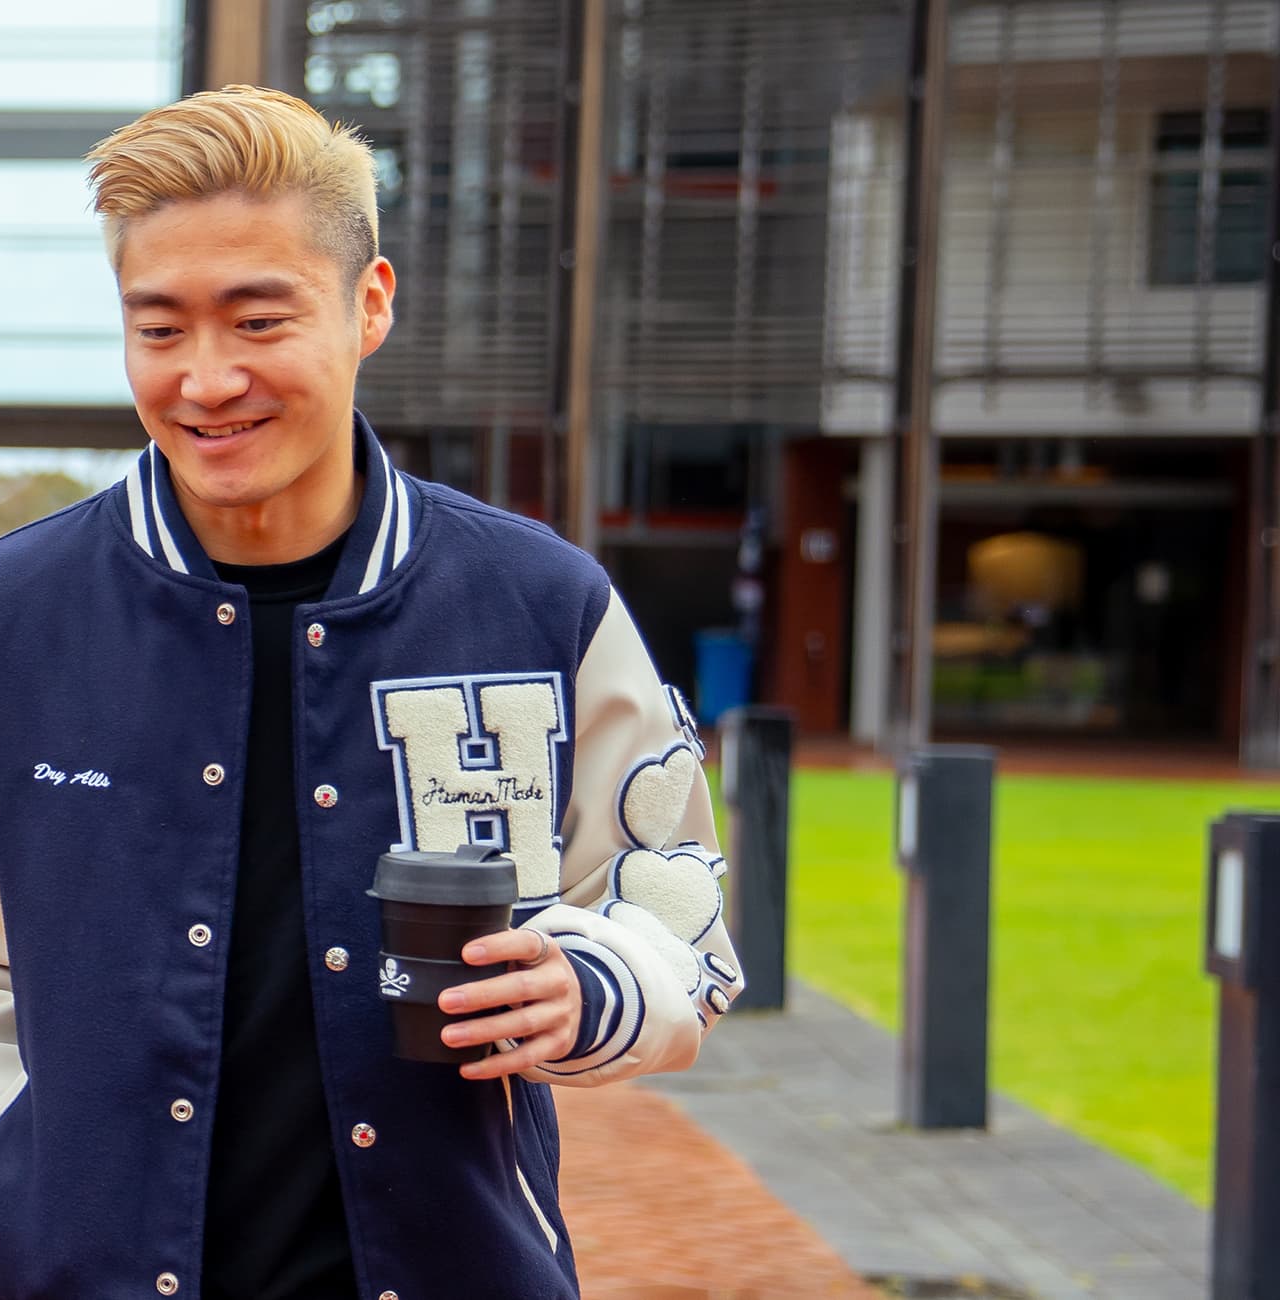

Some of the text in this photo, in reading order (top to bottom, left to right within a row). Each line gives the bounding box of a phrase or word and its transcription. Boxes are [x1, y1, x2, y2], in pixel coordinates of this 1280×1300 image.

[33, 762, 111, 788] Dry Alls
[370, 672, 567, 909] H
